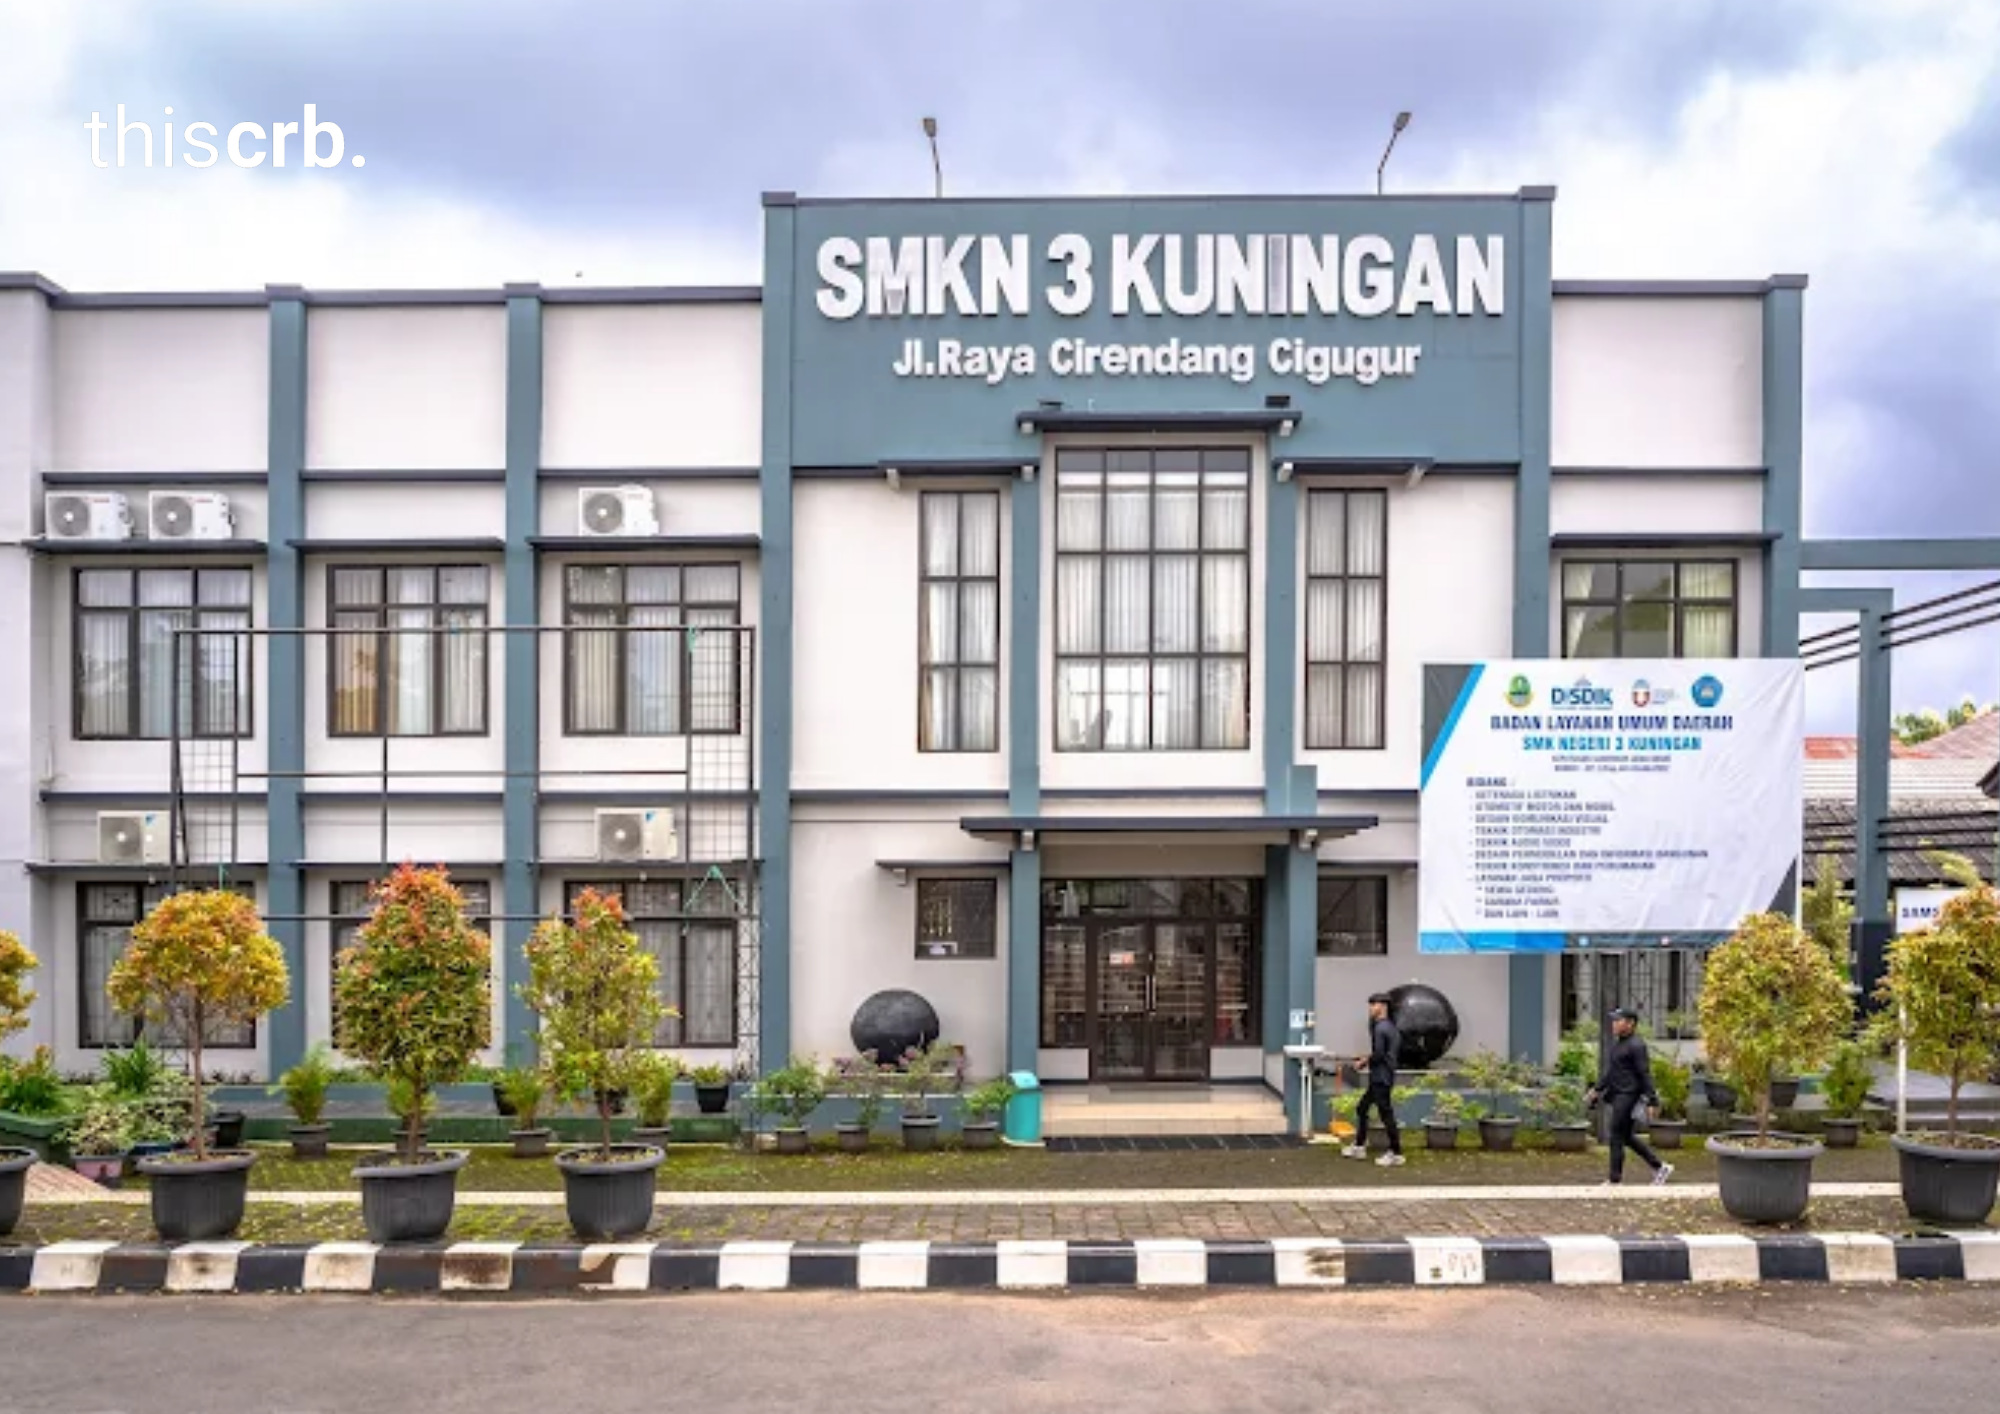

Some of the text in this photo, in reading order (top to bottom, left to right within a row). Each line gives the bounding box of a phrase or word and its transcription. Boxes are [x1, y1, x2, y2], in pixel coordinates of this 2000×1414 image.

[815, 233, 1506, 318] SMKN 3 KUNINGAN
[893, 339, 1422, 384] Jl.Raya Cirendang Cigugur
[1491, 716, 1733, 730] BADAN LAYANAN UMUM DAERAH
[1523, 737, 1553, 750] SMK
[1558, 737, 1610, 750] NEGERI
[1628, 737, 1702, 750] KUNINGAN
